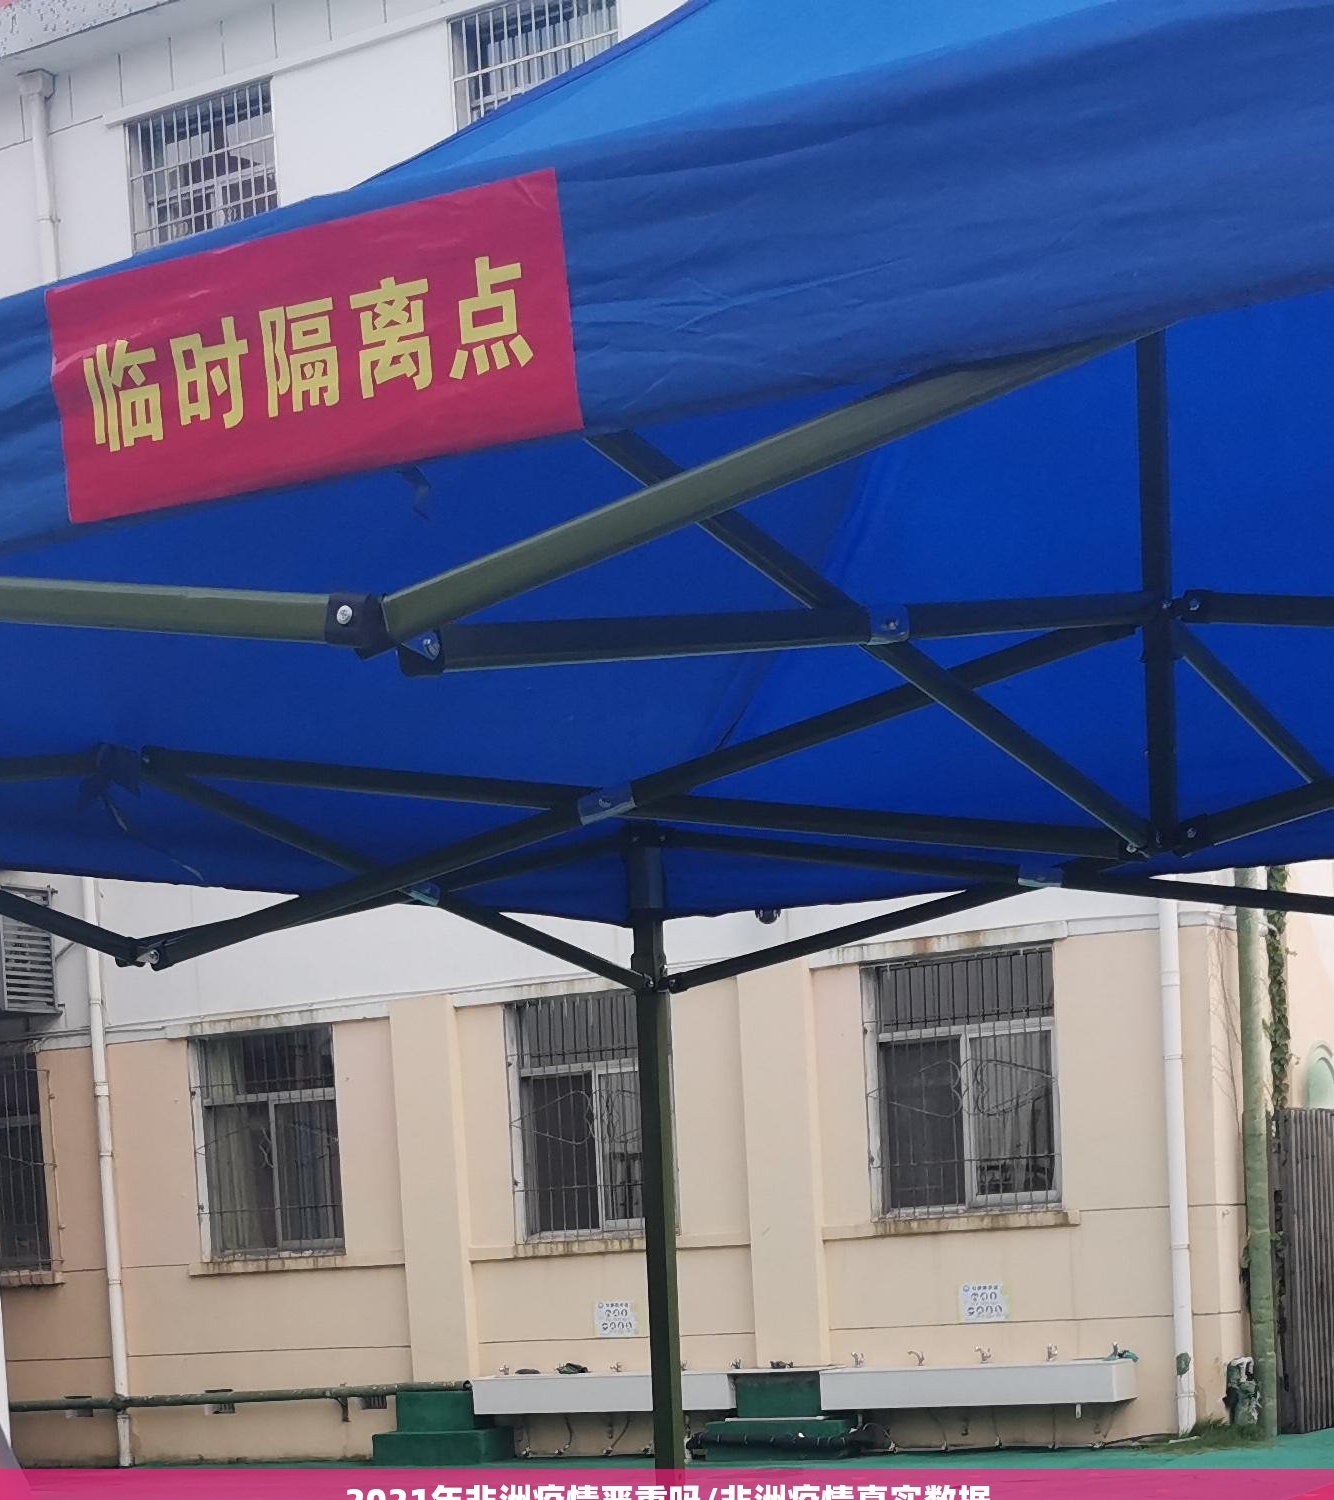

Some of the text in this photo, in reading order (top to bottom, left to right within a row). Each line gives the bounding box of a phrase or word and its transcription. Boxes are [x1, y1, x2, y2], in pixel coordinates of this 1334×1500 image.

[83, 256, 534, 453] 临时隔离点
